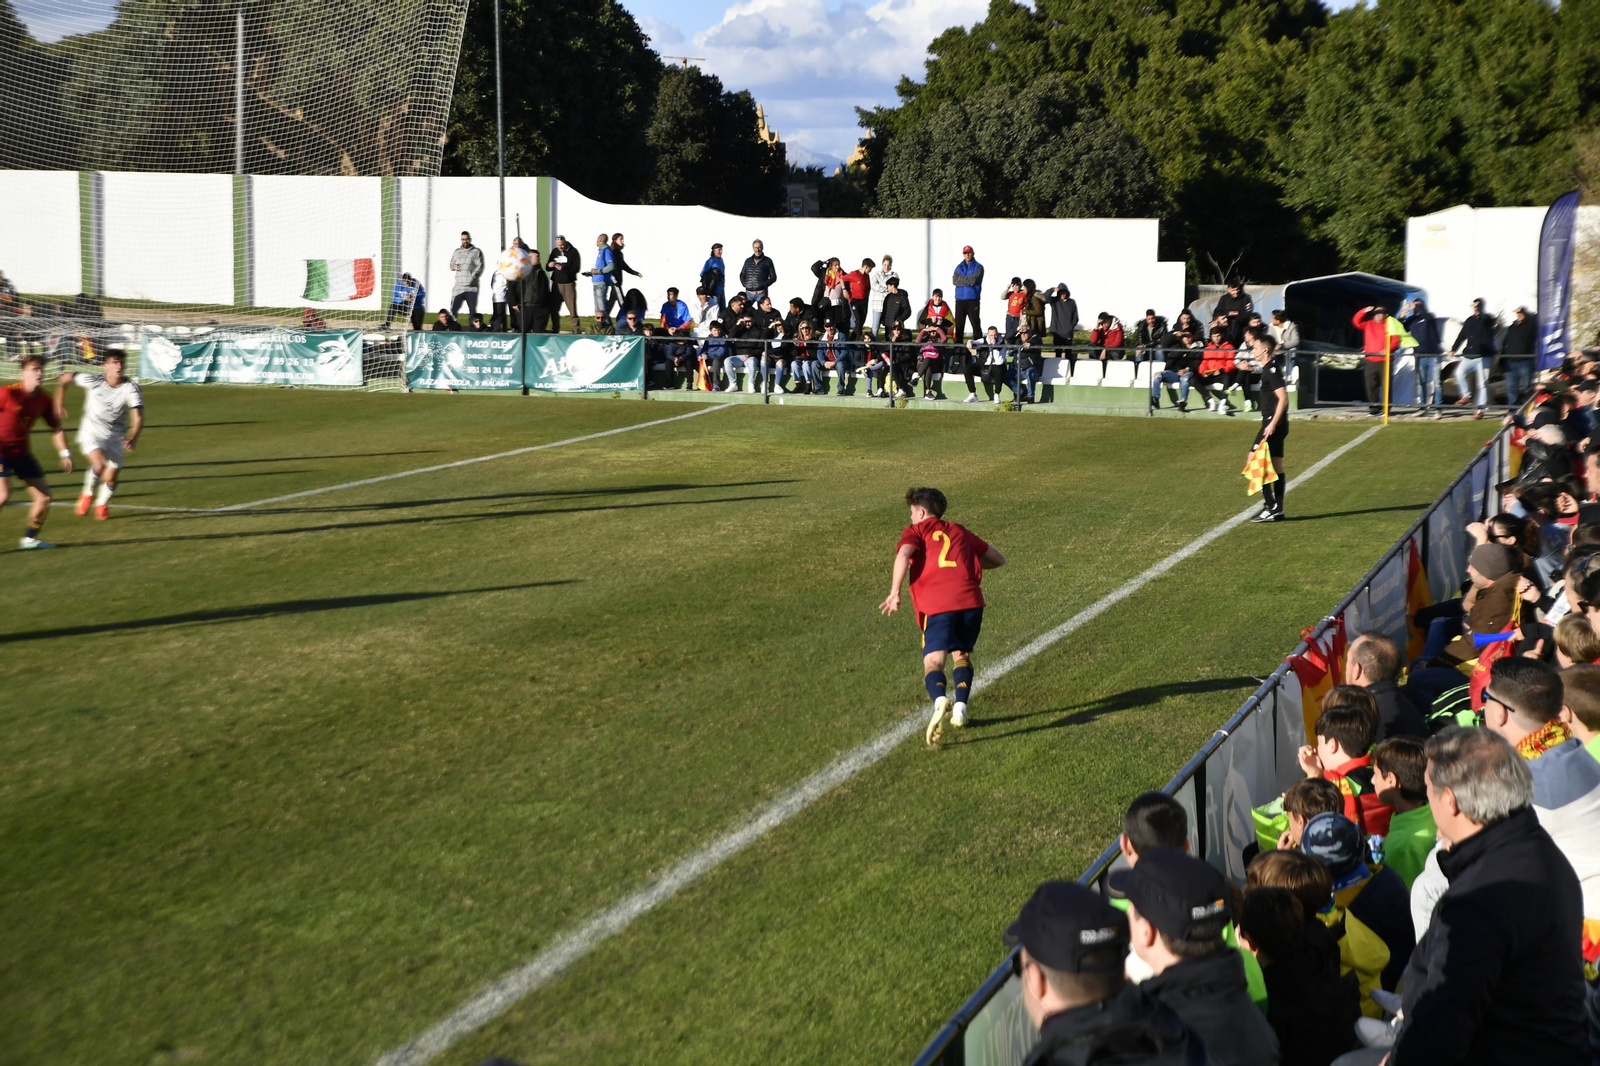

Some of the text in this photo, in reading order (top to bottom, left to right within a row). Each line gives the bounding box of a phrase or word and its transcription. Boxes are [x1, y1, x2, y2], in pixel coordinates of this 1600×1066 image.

[467, 340, 488, 348] PACO
[288, 358, 299, 366] 26
[304, 358, 314, 366] 13
[441, 379, 472, 387] RRIOLA,
[482, 378, 510, 386] MÁLAGA
[932, 530, 957, 568] 2
